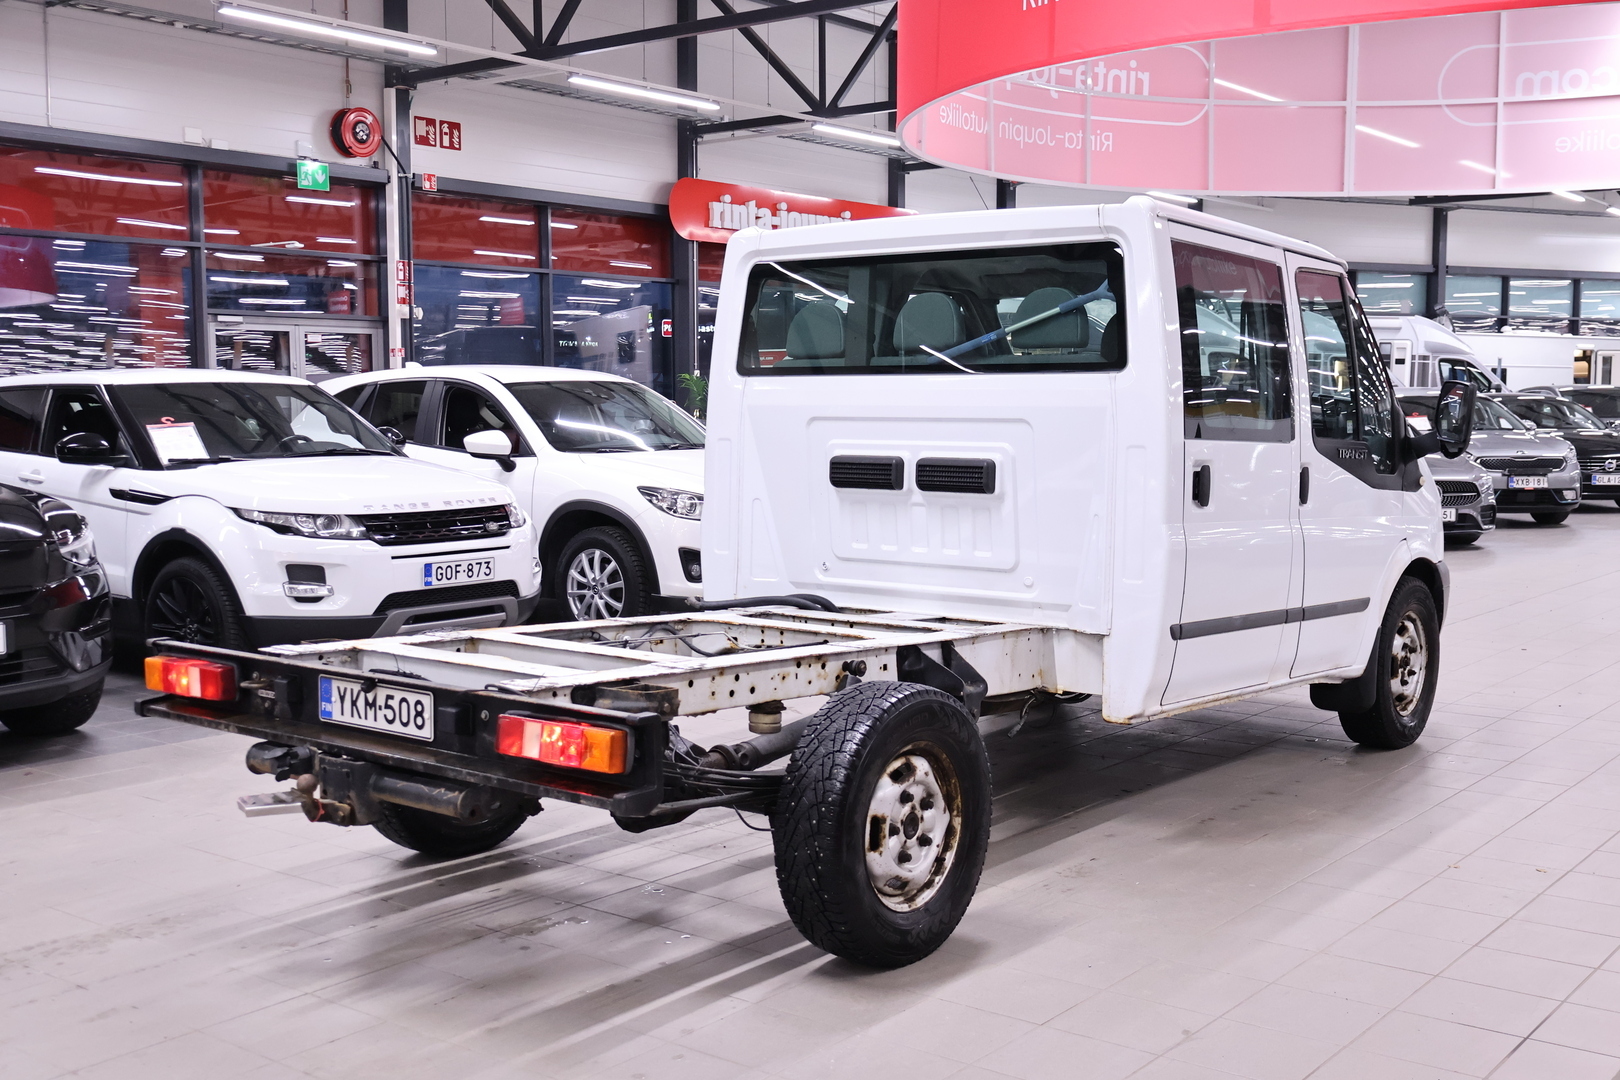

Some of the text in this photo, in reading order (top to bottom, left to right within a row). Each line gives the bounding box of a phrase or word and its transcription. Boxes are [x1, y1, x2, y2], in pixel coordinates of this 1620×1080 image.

[1337, 448, 1368, 460] TRANSIT
[435, 560, 493, 582] GOF-873
[321, 701, 333, 713] FIN
[336, 685, 426, 731] YKM-508
